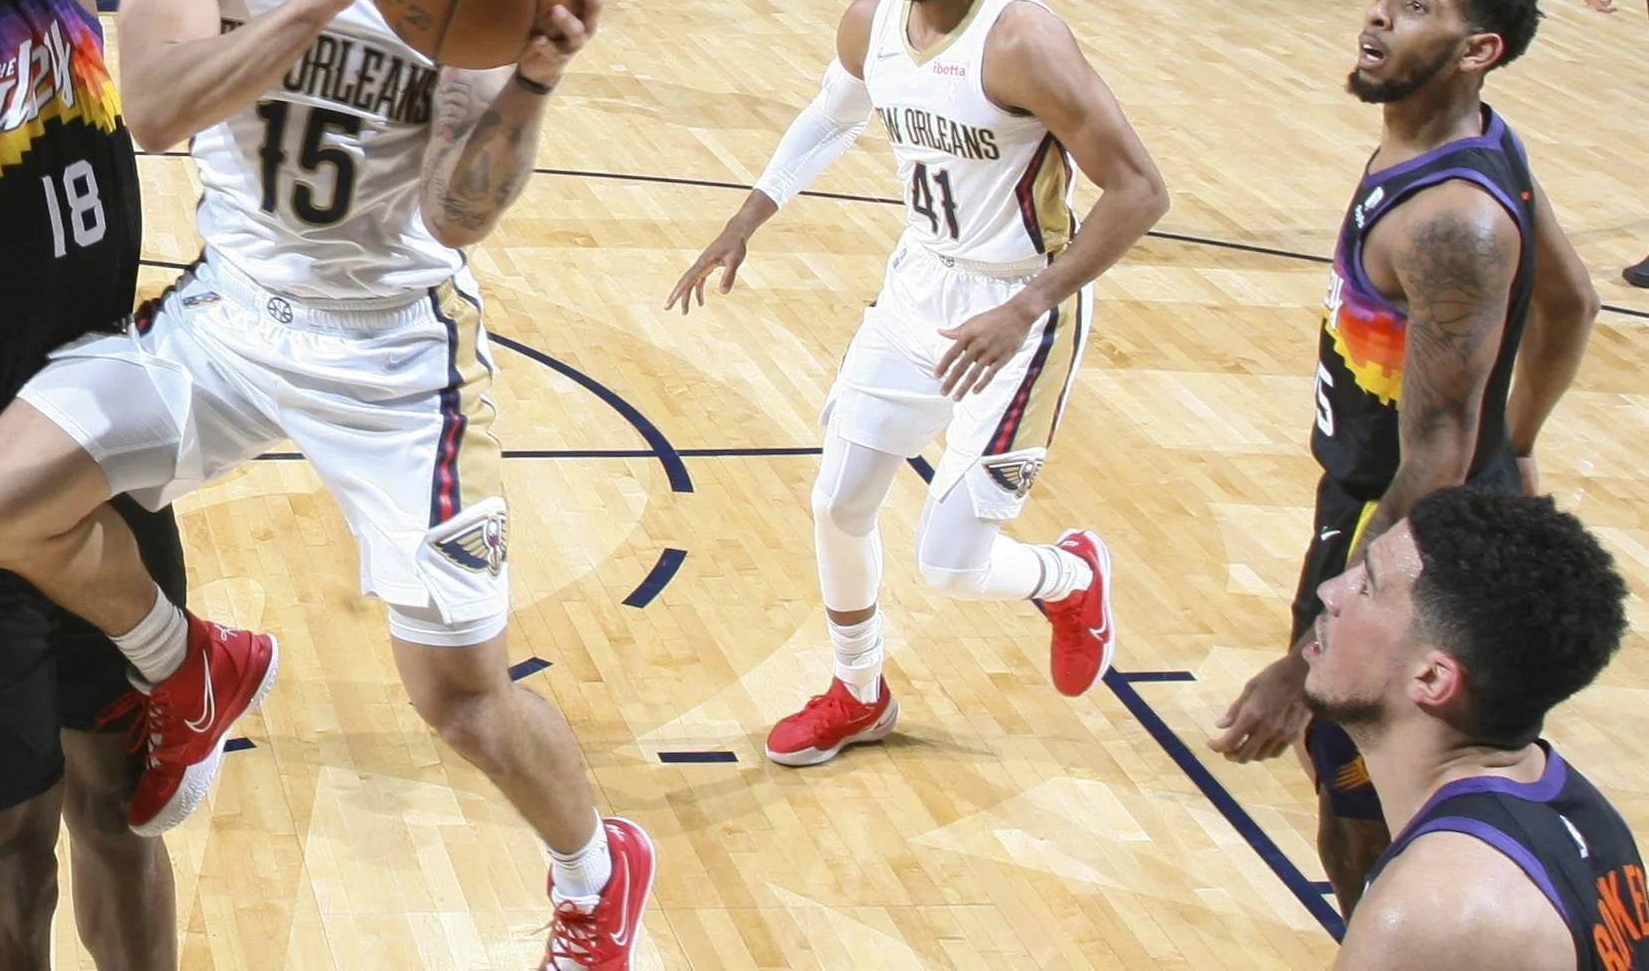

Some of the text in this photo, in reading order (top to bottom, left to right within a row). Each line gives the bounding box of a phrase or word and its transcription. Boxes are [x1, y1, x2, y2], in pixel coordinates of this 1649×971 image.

[932, 61, 966, 77] ibotta
[256, 99, 365, 225] 15
[904, 108, 1001, 161] ORLEANS
[41, 159, 106, 258] 18
[912, 160, 959, 241] 41
